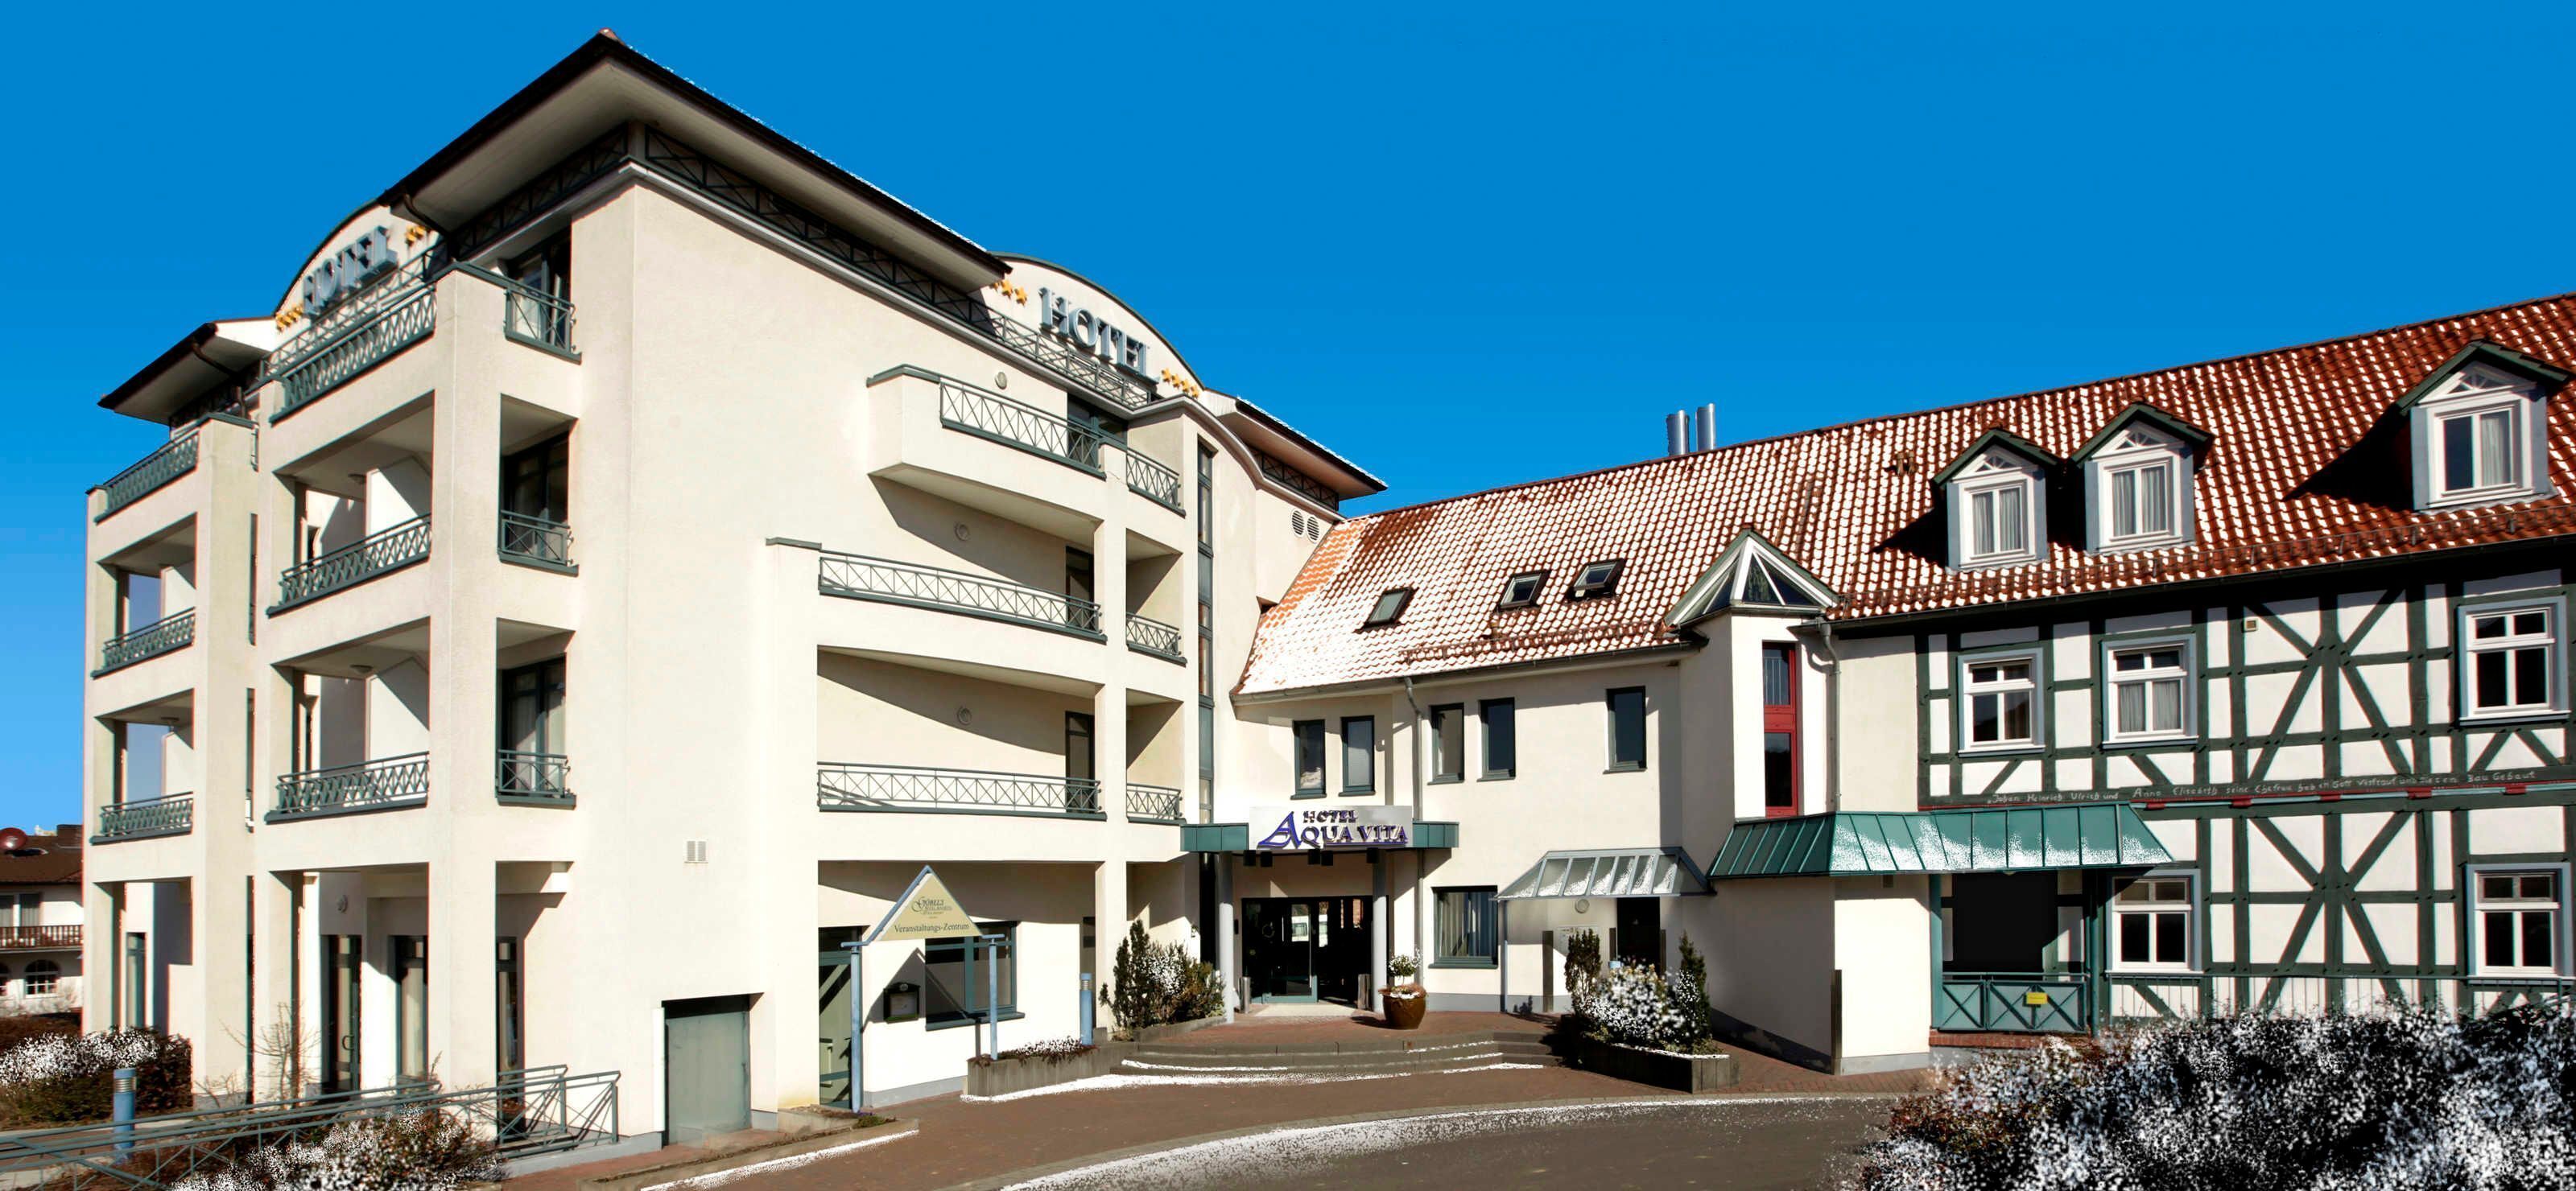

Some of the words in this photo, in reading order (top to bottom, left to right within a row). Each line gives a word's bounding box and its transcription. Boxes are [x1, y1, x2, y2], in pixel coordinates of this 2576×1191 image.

[1038, 287, 1160, 384] HOTEL
[2226, 785, 2248, 793] seine
[1302, 810, 1357, 823] HOTEL
[1257, 811, 1353, 849] AQUA
[1357, 824, 1408, 843] VITA
[894, 922, 969, 933] Veranstaltungs-Zentrum
